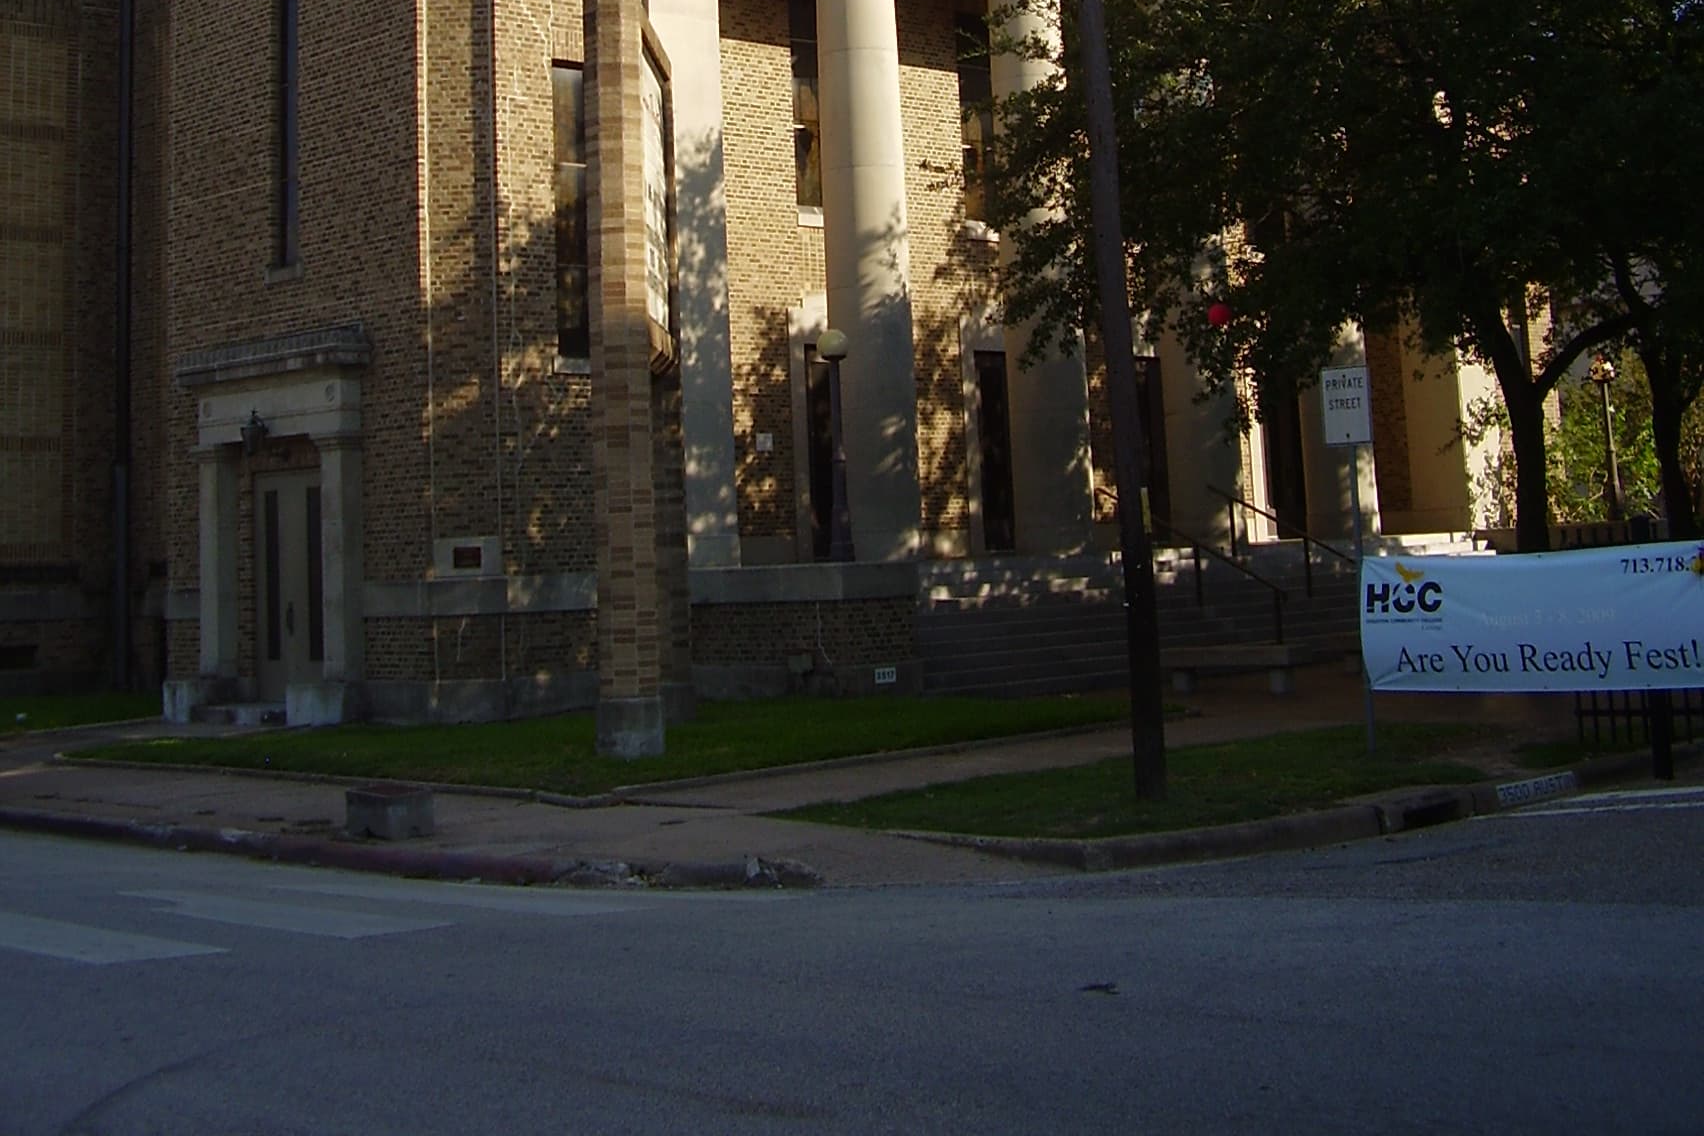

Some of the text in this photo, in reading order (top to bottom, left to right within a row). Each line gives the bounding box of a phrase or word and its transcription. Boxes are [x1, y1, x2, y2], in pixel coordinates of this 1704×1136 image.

[1325, 377, 1363, 390] PRIVATE
[1328, 397, 1361, 410] STREET
[1619, 556, 1697, 574] 713.718.
[1366, 581, 1443, 613] HCC
[1396, 639, 1703, 679] Are You Ready Fest!
